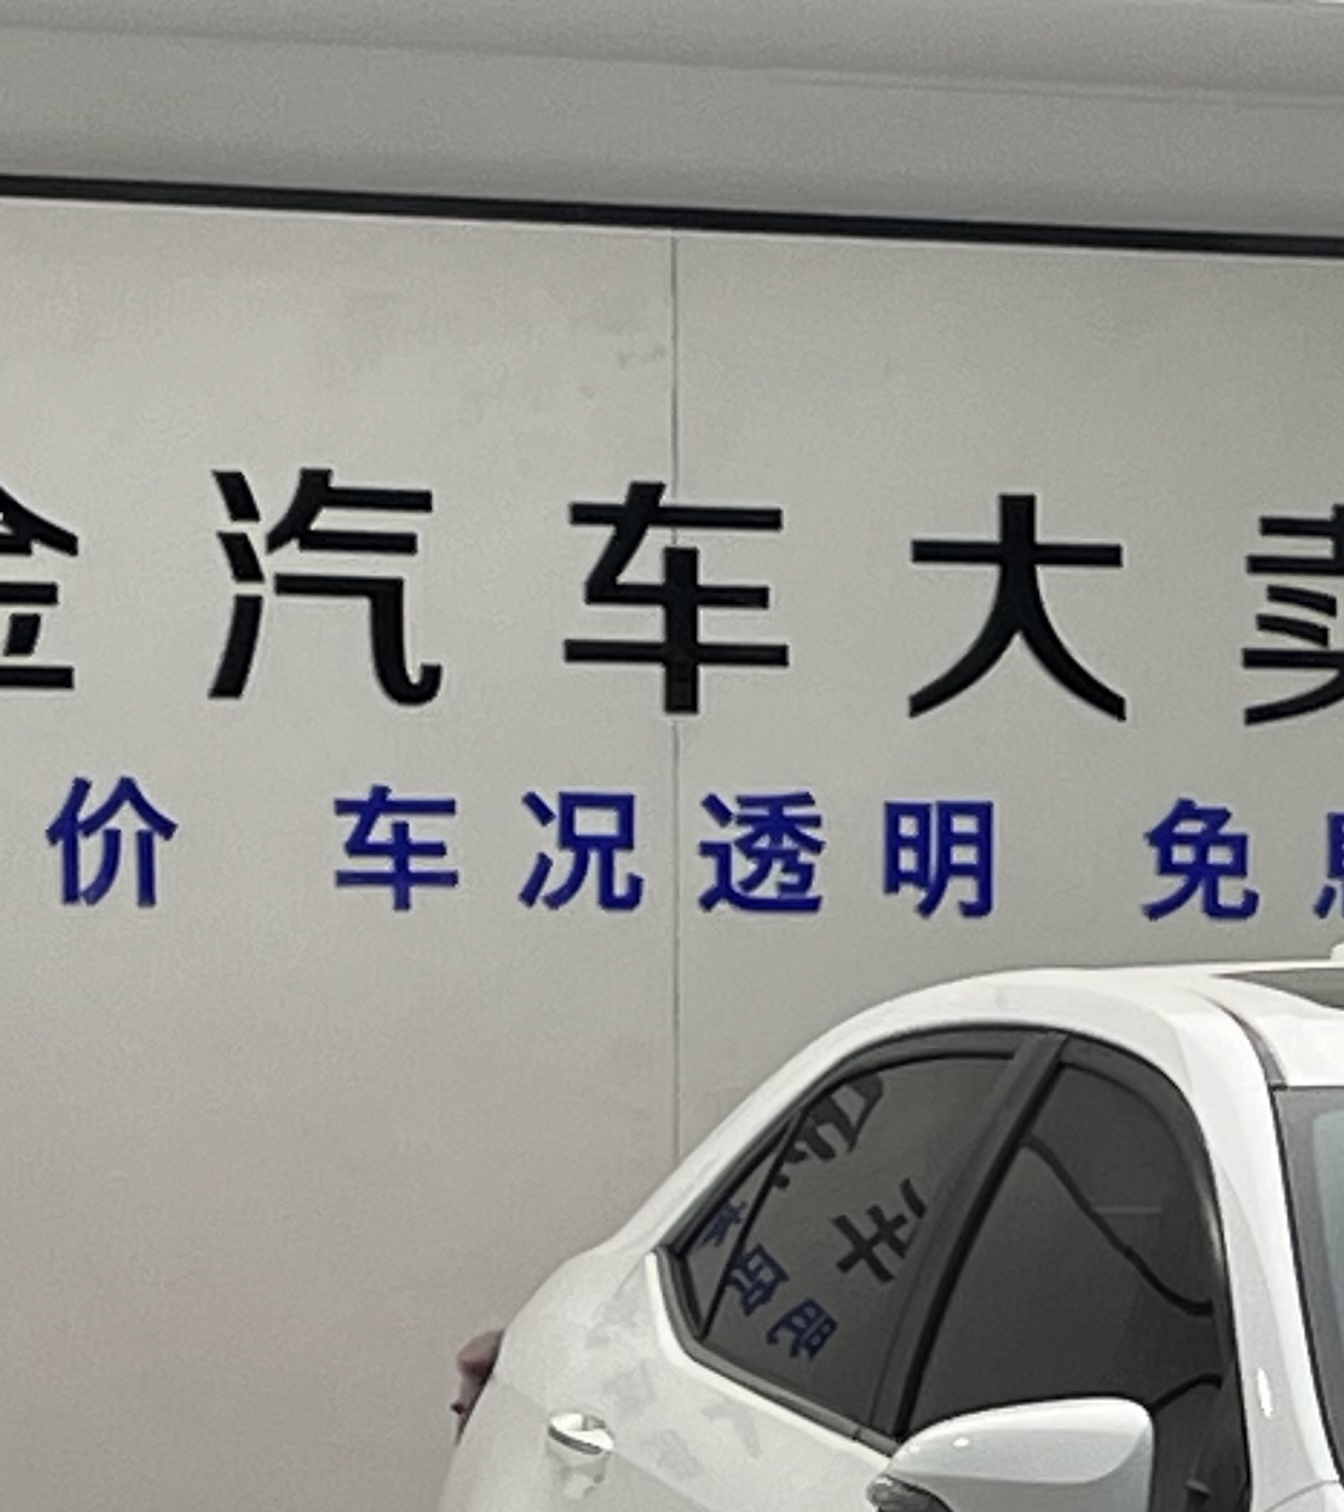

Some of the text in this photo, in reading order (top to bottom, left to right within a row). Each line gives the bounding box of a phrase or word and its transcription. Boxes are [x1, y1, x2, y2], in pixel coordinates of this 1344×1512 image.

[46, 777, 177, 908] 价
[333, 785, 995, 919] 车况透明
